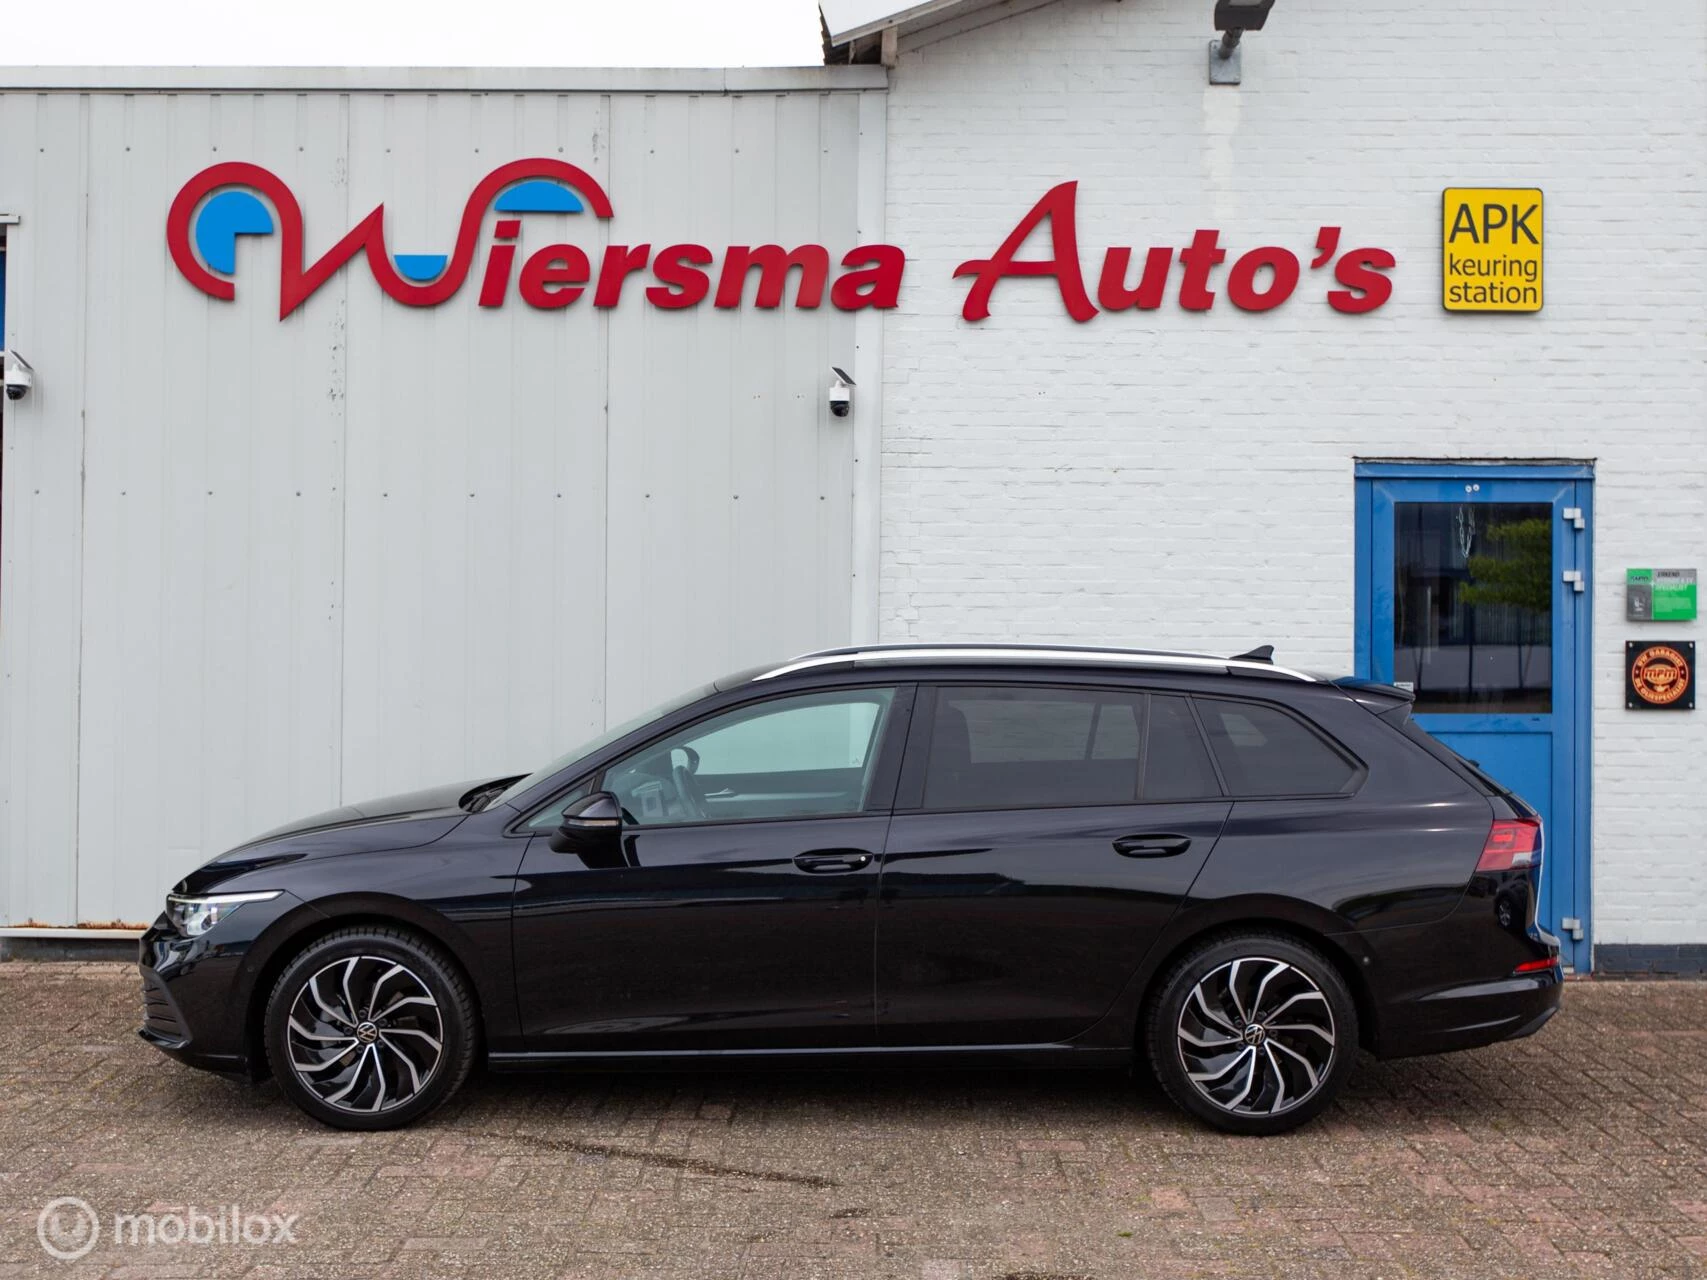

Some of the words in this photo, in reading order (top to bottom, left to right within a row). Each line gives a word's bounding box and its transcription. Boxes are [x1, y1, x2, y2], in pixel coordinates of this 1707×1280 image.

[167, 158, 905, 319] Wiersma
[954, 181, 1396, 323] Auto's
[1448, 203, 1539, 244] APK
[1449, 253, 1537, 282] keuring
[1449, 282, 1537, 303] station
